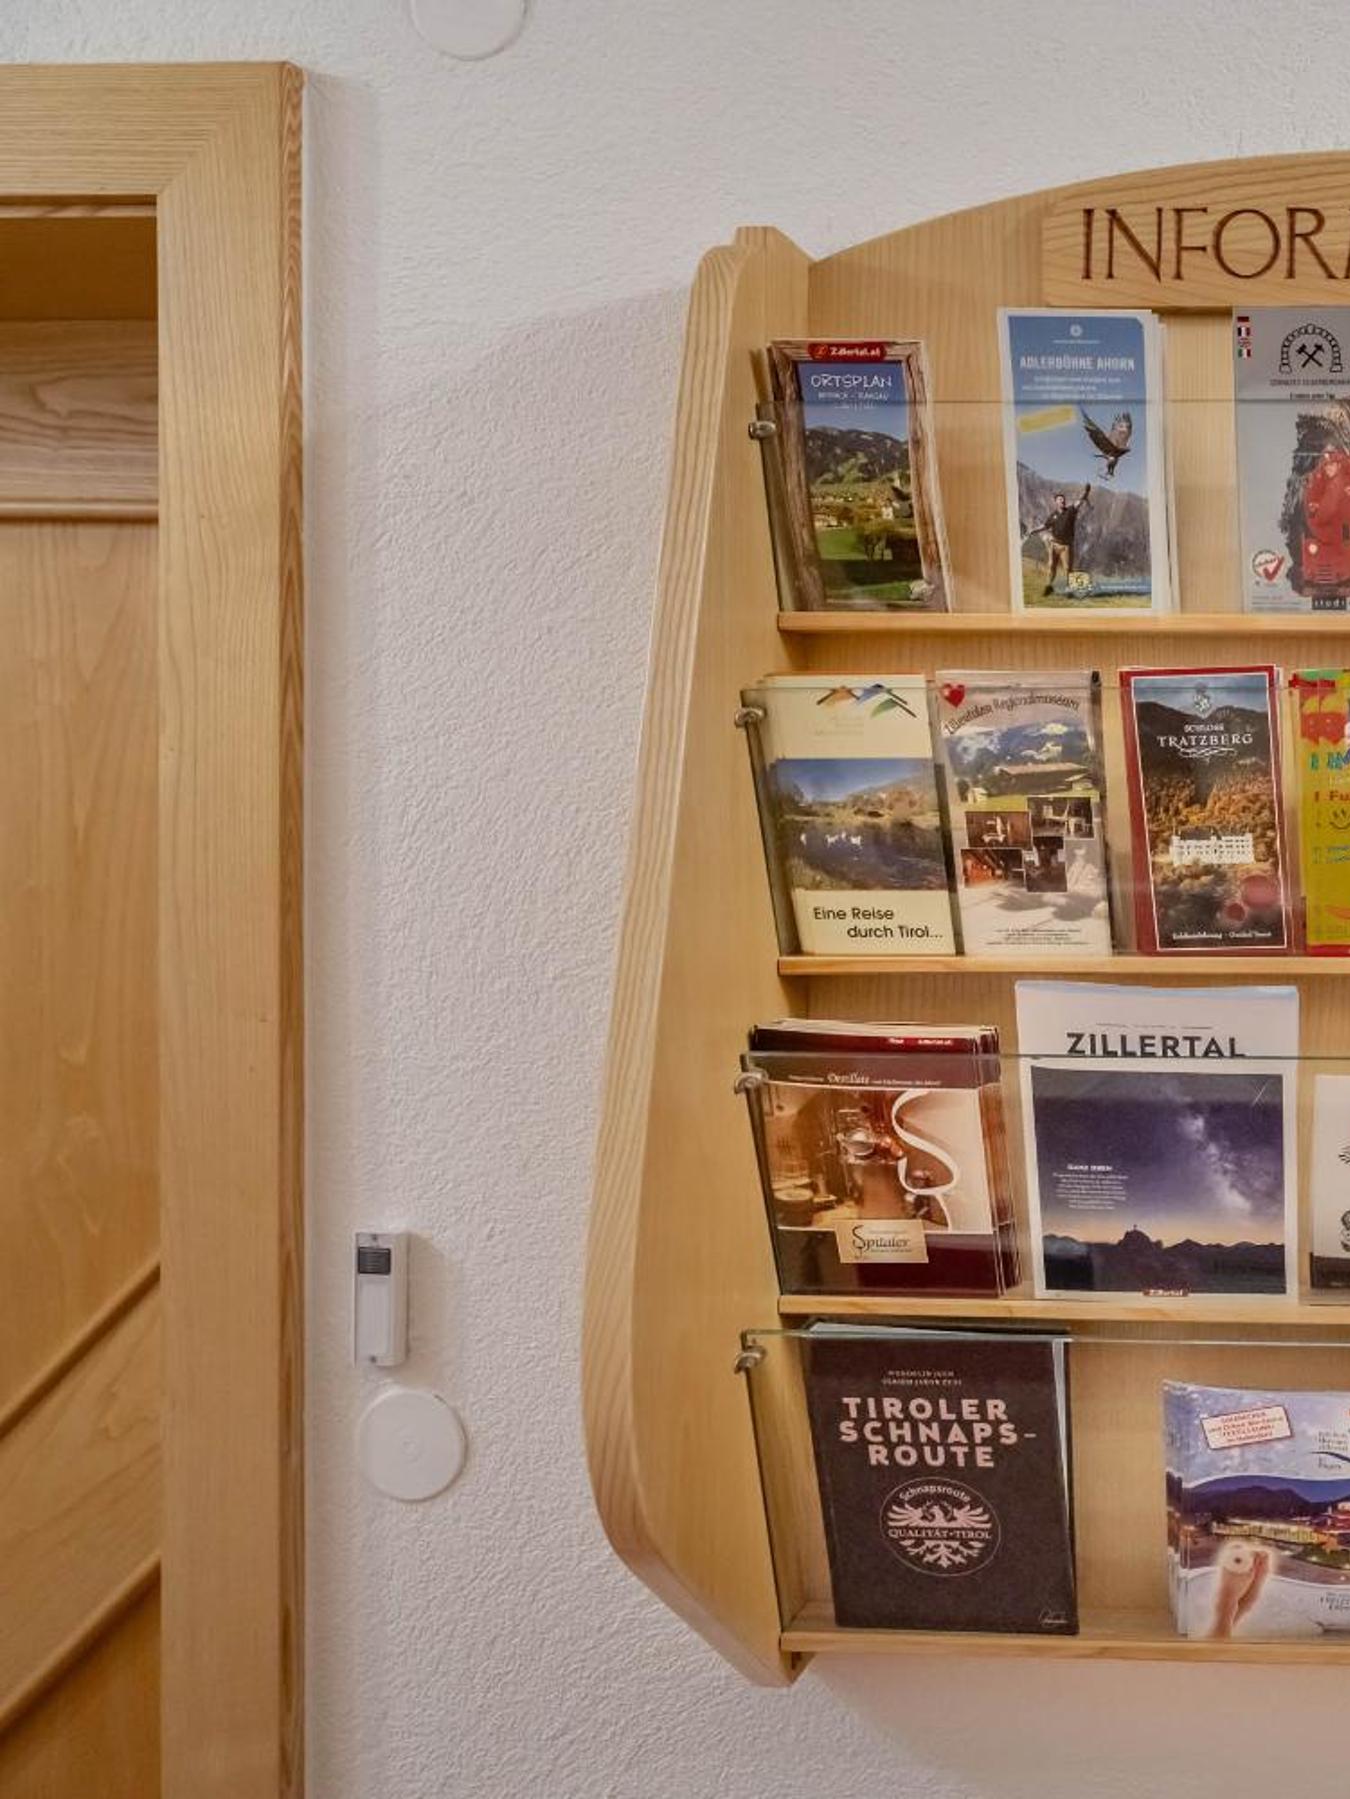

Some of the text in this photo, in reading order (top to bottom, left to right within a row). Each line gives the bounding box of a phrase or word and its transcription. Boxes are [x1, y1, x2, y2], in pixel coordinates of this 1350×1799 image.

[1019, 354, 1135, 371] ADLERBÜHNE AHORN
[810, 373, 892, 388] ORTSPLAN
[1157, 734, 1254, 748] TRATZBERG
[813, 906, 895, 921] Eine Reise
[847, 924, 894, 939] durch
[1066, 1032, 1246, 1059] ZILLERTAL
[842, 1397, 1008, 1421] TIROLER
[839, 1421, 1037, 1445] SCHNAPS-
[868, 1445, 995, 1468] ROUTE
